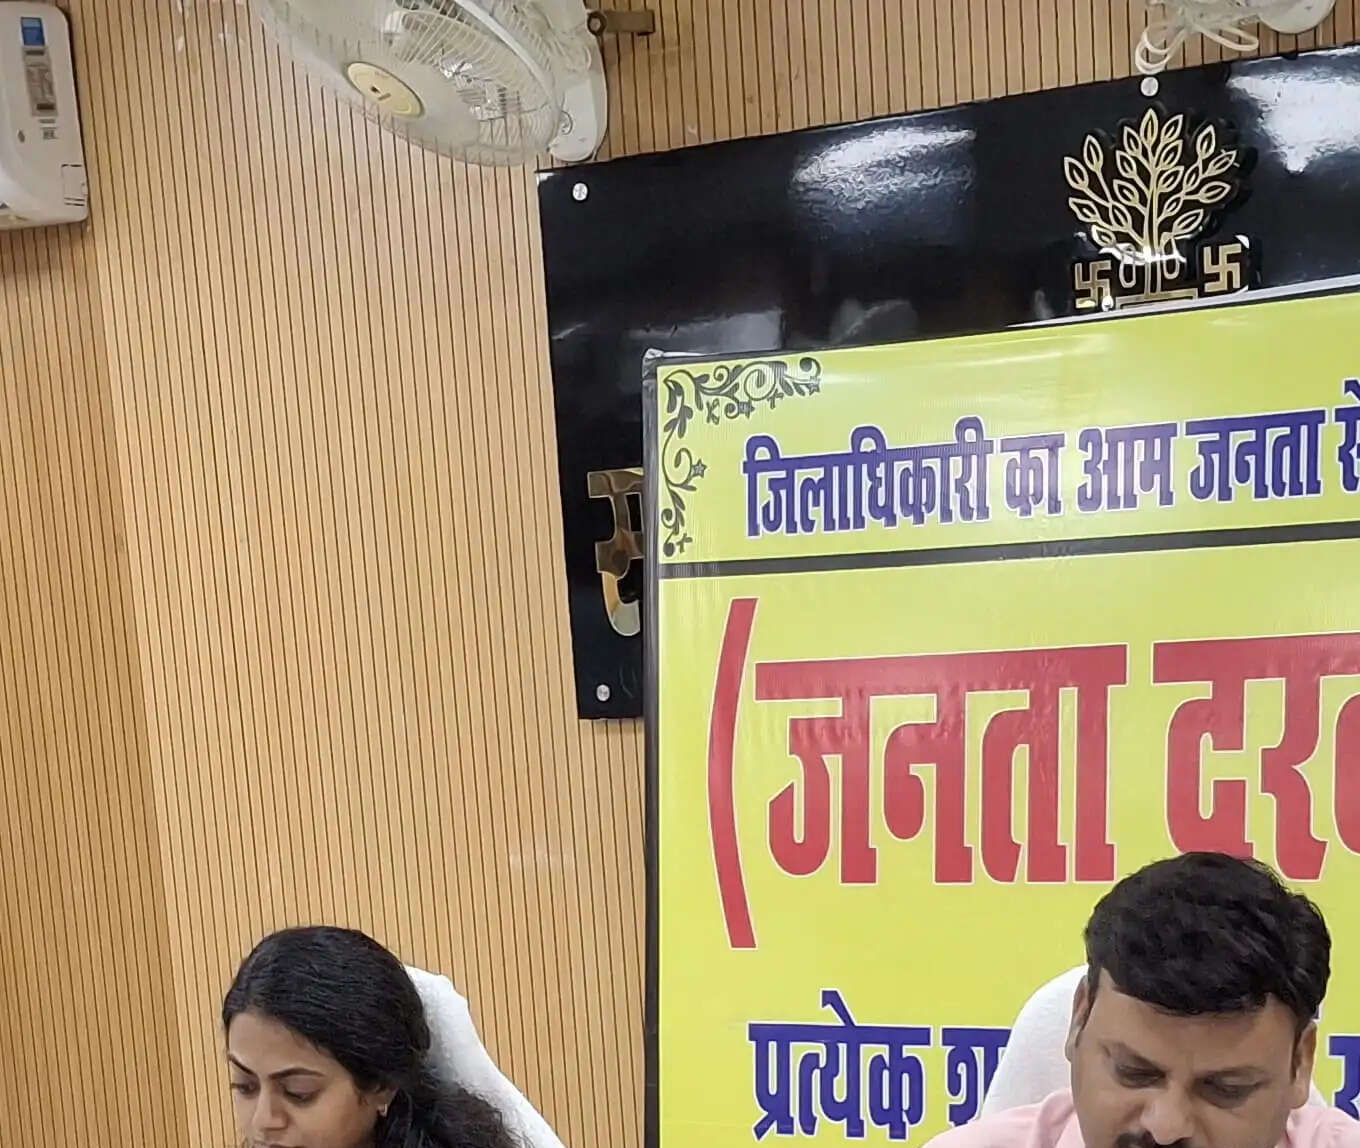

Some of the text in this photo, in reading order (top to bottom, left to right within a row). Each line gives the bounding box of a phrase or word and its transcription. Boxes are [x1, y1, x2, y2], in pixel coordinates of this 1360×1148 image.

[742, 416, 994, 536] जिलाधिकारी
[1000, 433, 1065, 517] का
[1077, 422, 1178, 512] आम
[1185, 409, 1327, 502] जनता
[747, 988, 932, 1142] प्रत्येक
